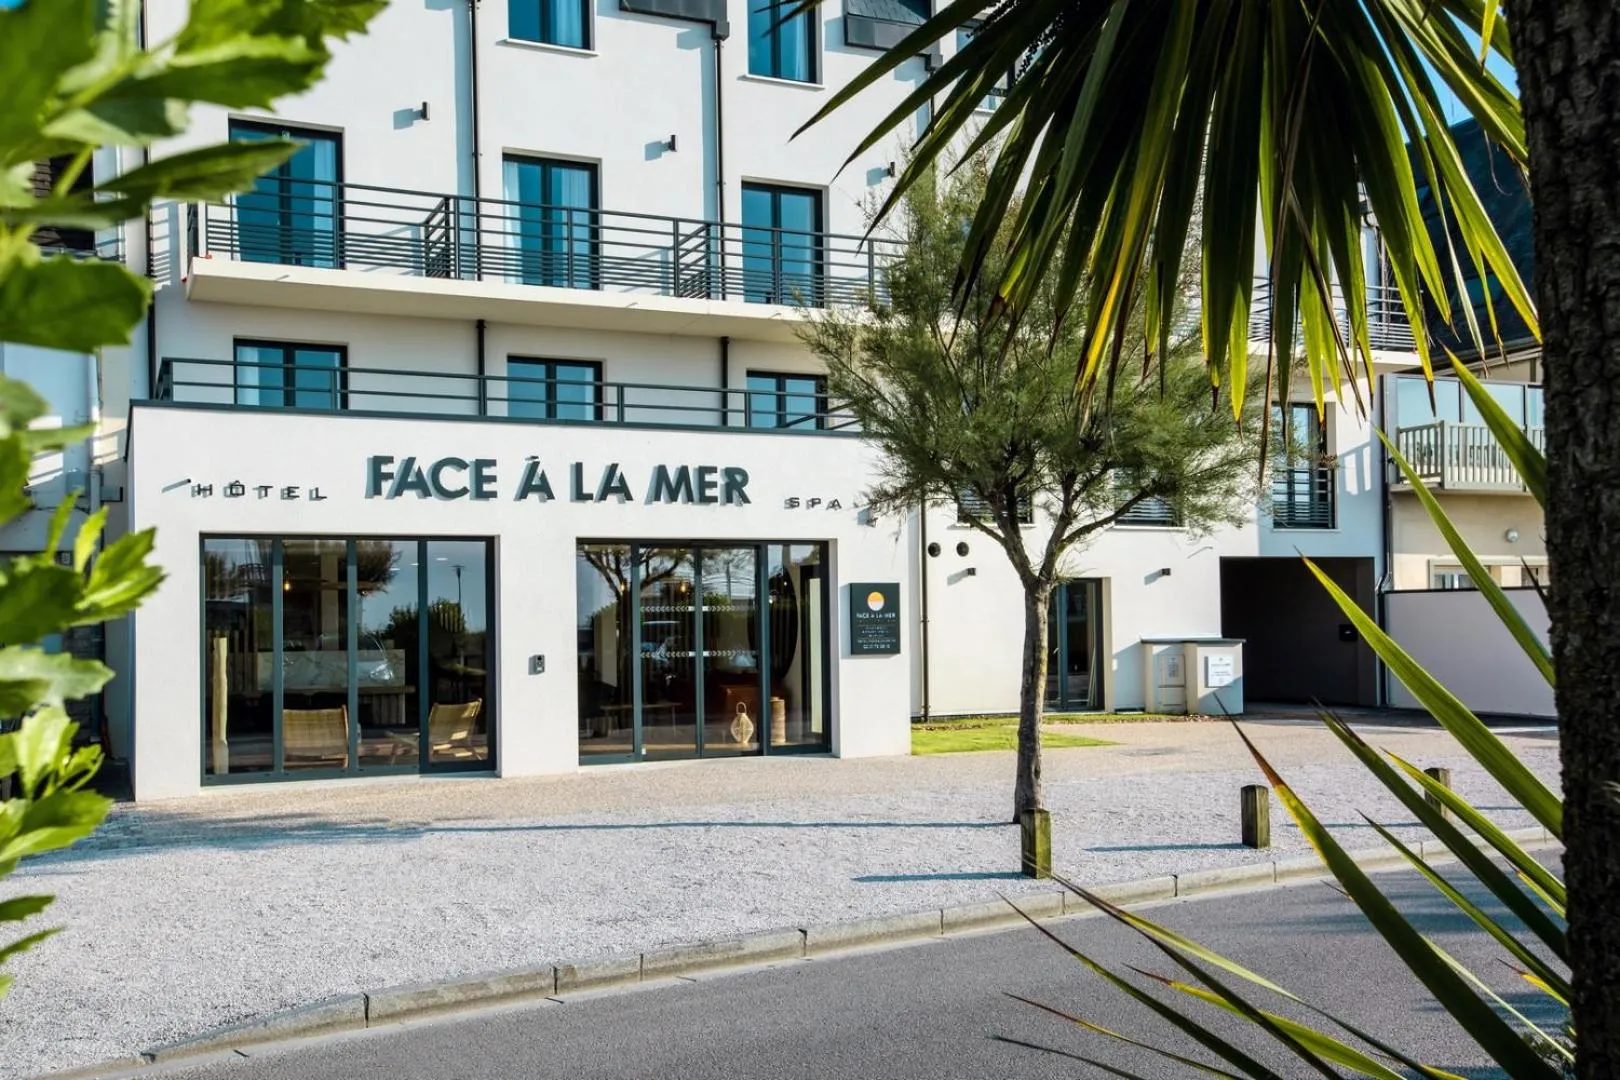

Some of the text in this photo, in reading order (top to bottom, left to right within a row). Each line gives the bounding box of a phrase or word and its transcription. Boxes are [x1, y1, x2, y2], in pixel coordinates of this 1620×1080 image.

[196, 479, 328, 500] HÔTEL
[371, 455, 752, 504] FACE À LA MER
[787, 496, 842, 510] SPA
